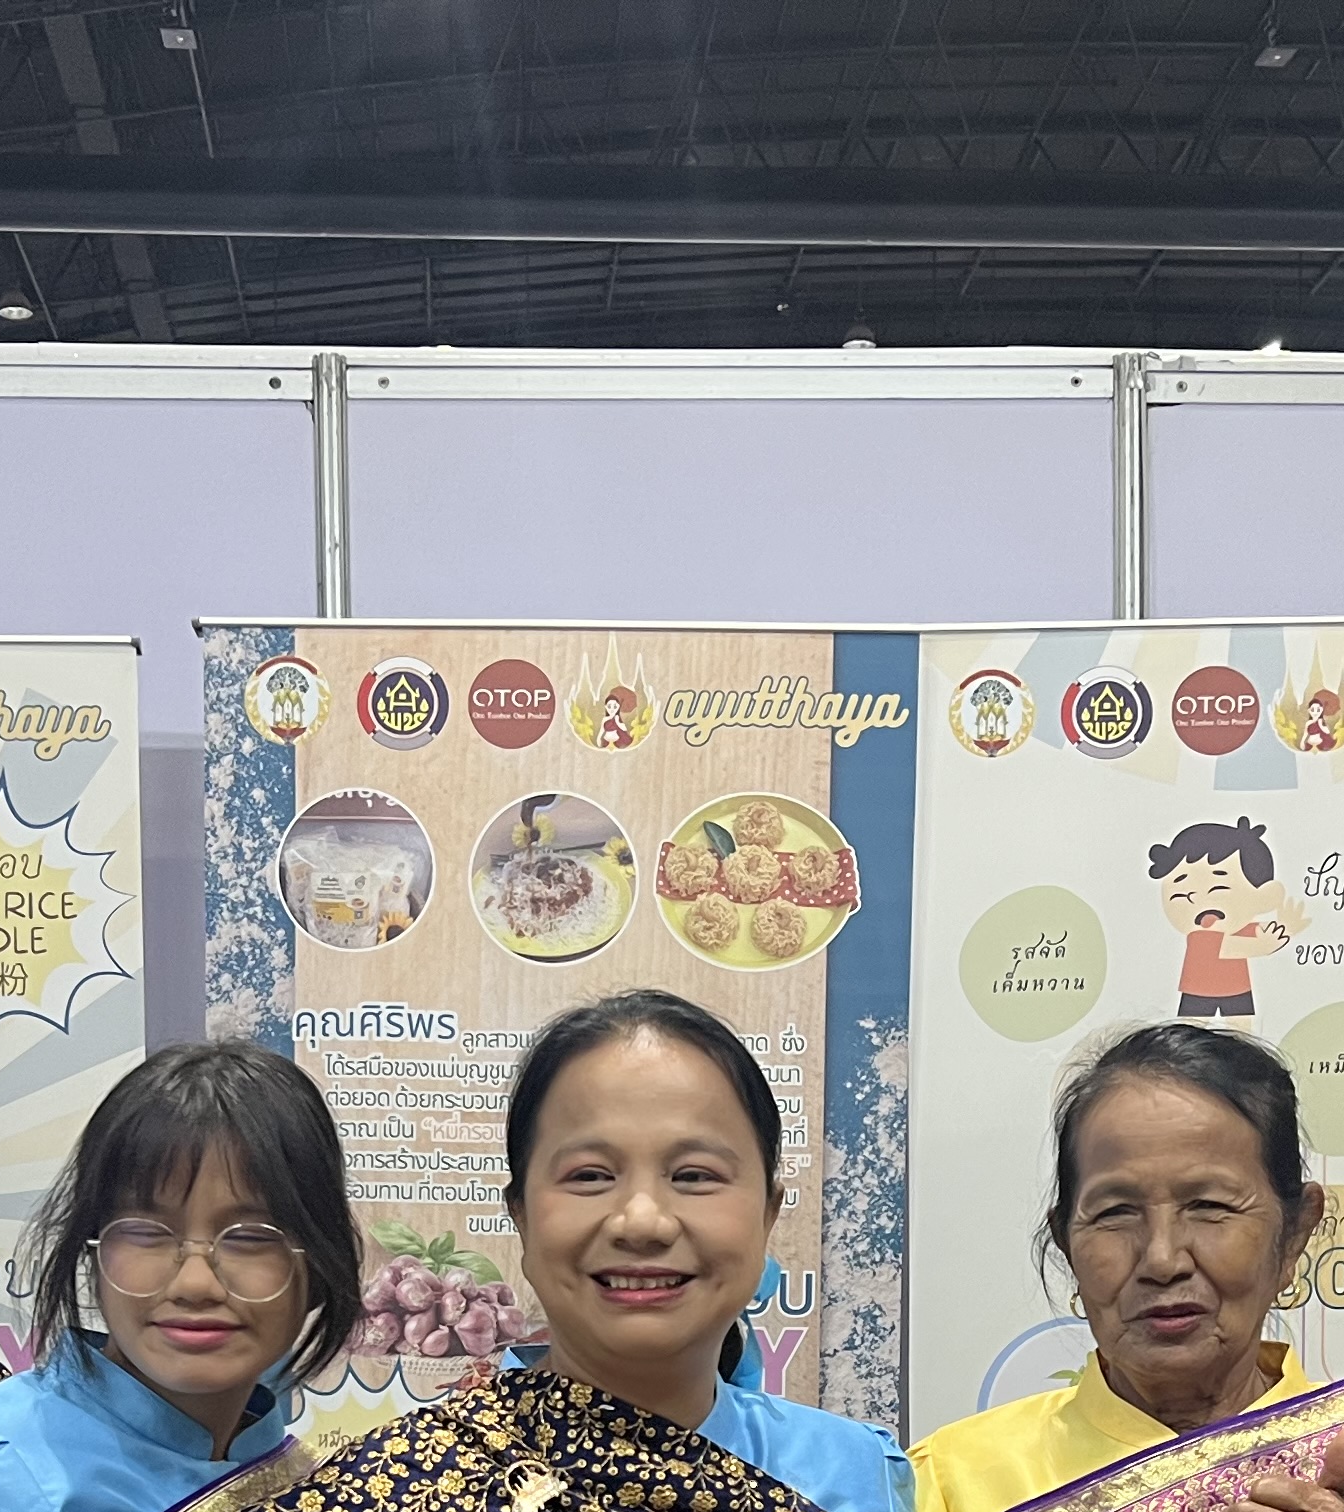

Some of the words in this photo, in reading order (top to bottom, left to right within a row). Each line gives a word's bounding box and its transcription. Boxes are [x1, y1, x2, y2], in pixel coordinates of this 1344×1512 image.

[472, 688, 551, 707] OTOP
[664, 676, 909, 746] ayutthaya
[1176, 695, 1255, 715] OTOP
[4, 891, 78, 920] RICE
[295, 1005, 456, 1049] คุณศิริพร
